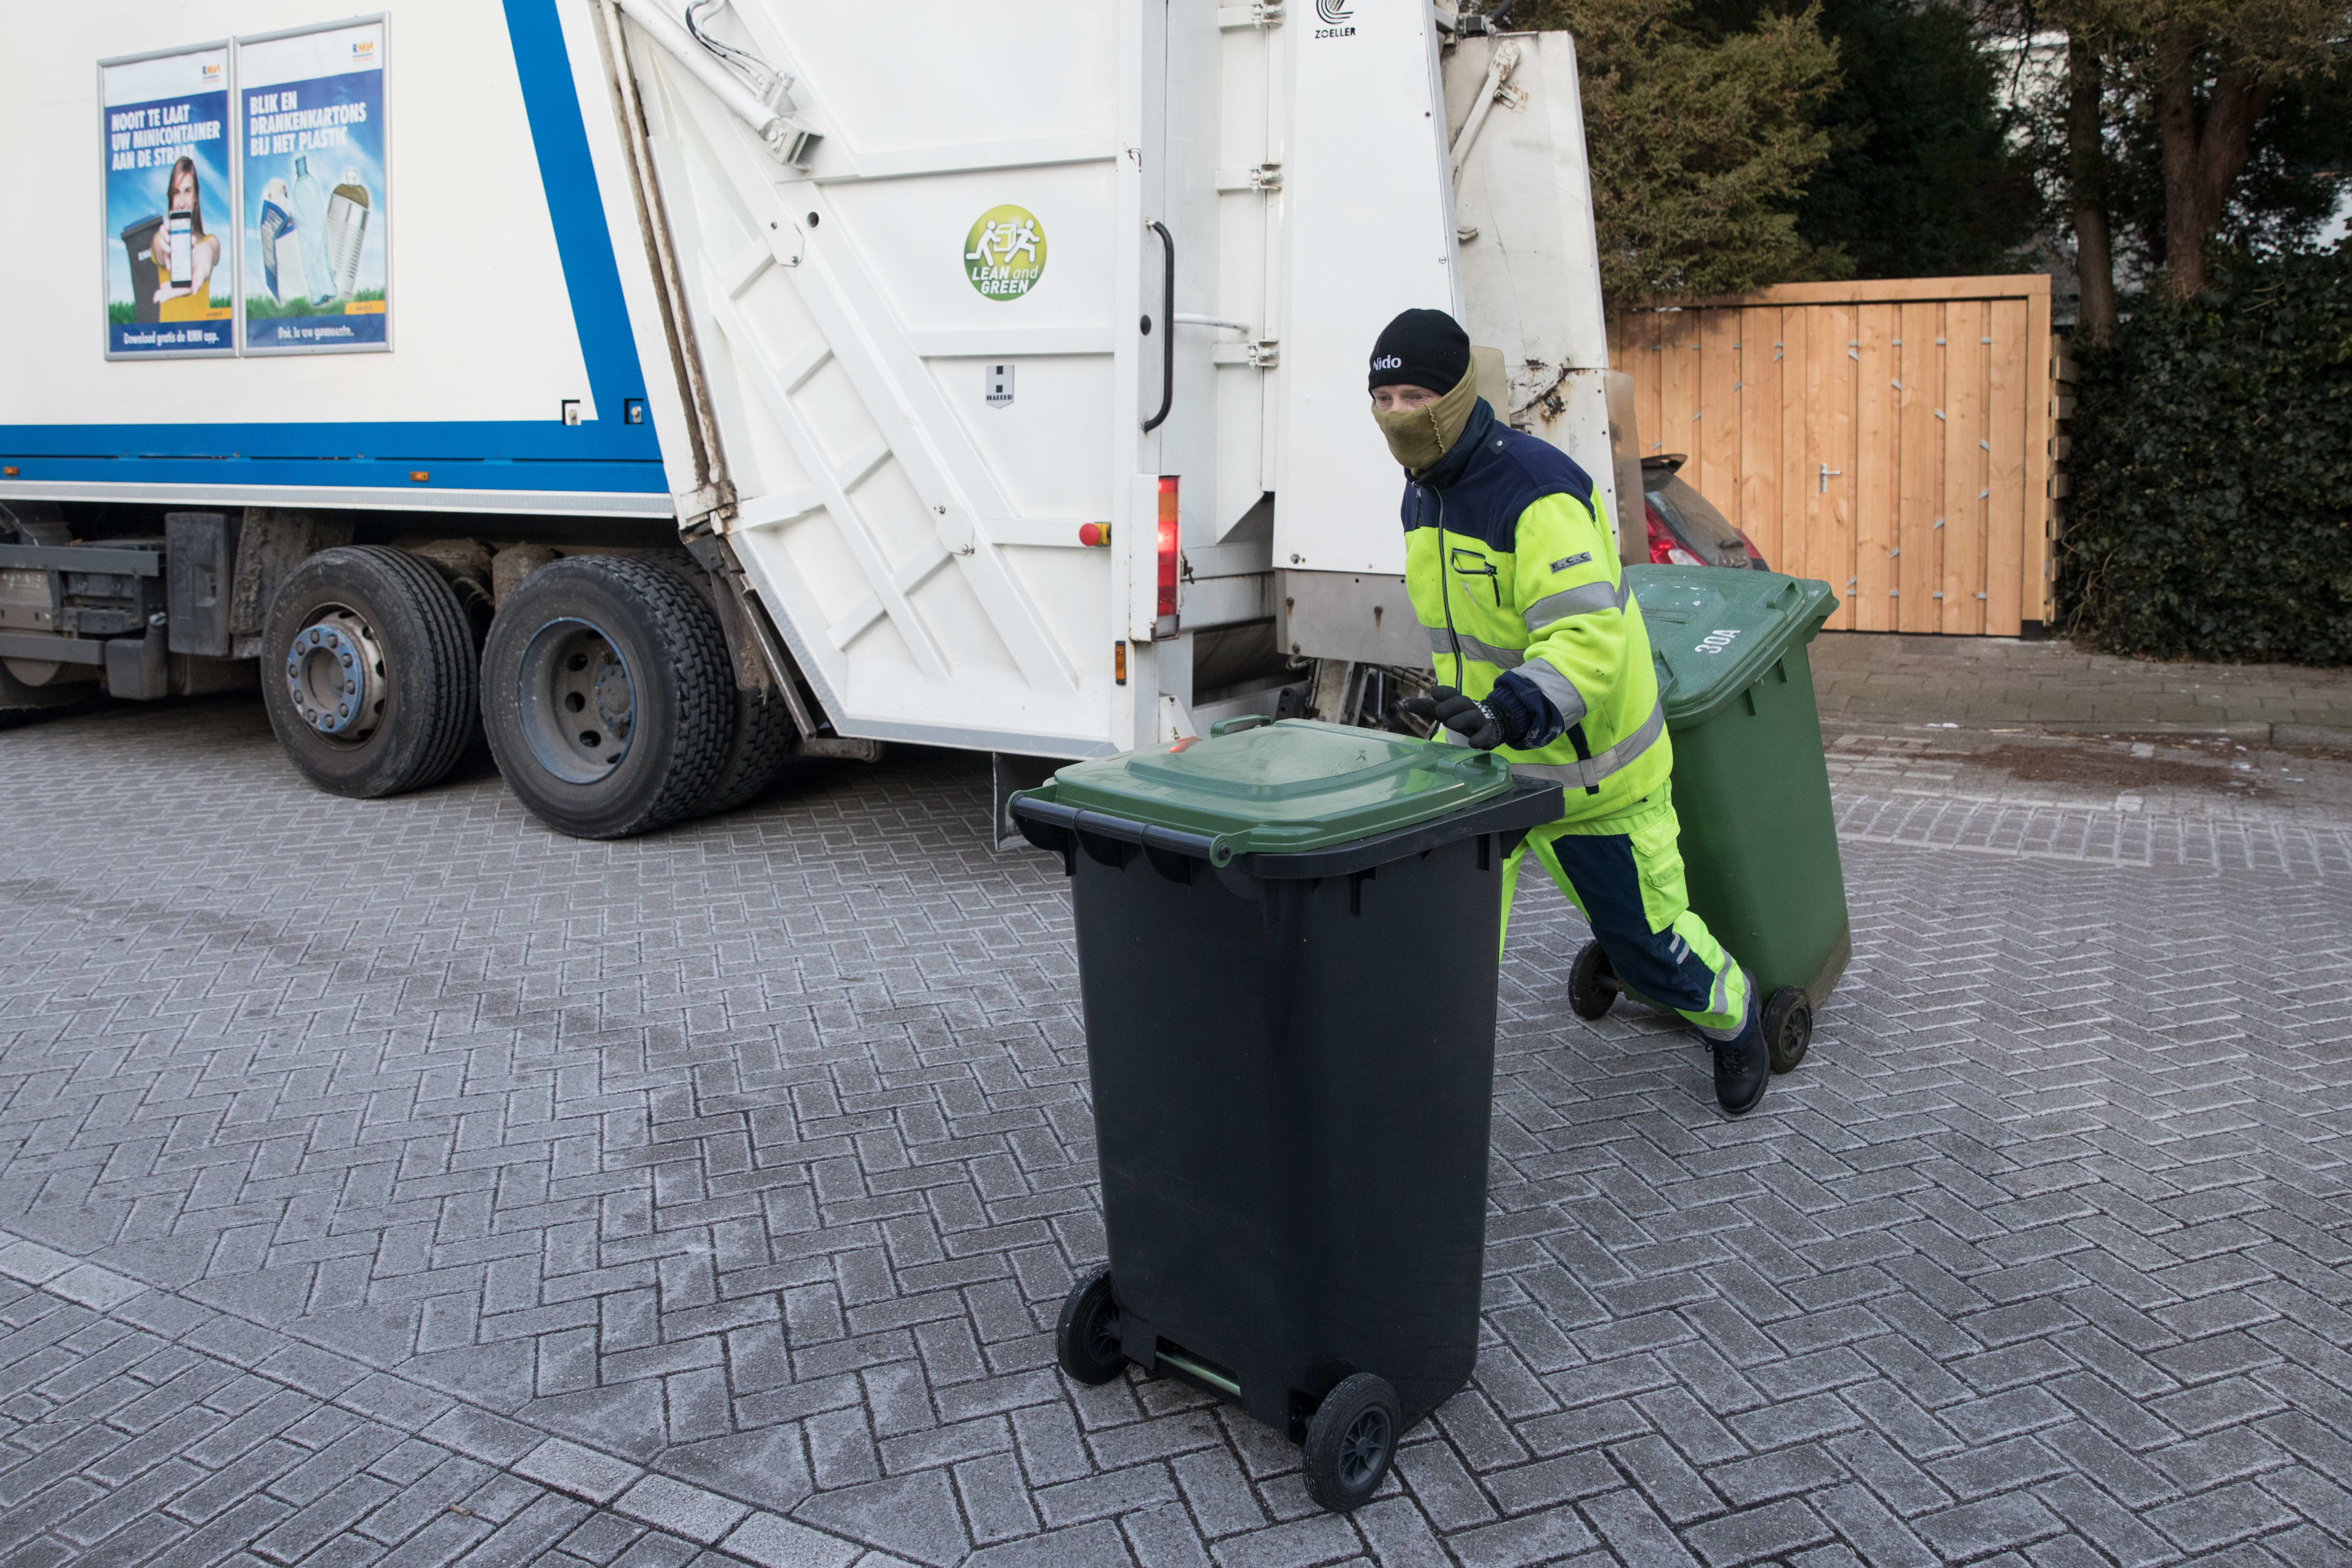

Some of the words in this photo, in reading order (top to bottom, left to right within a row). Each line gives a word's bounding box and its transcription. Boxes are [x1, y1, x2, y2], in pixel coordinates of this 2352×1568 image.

[1315, 27, 1355, 39] ZOELLER
[250, 93, 279, 116] BLIK
[281, 90, 298, 111] EN
[111, 110, 146, 132] NOOIT
[147, 108, 160, 127] TE
[162, 104, 190, 125] LAAT
[250, 102, 367, 136] DRANKENKARTONS
[111, 132, 131, 151] UW
[133, 120, 221, 149] MINICONTAINER
[250, 136, 270, 157] BIJ
[273, 132, 296, 154] HET
[299, 126, 349, 151] PLASTIC
[112, 151, 135, 171] AAN
[137, 149, 152, 168] DE
[154, 143, 195, 166] STRAAT
[972, 266, 1010, 281] LEAN
[1013, 265, 1039, 279] and
[981, 279, 1029, 294] GREEN
[124, 330, 156, 344] Download
[156, 331, 176, 347] gratis
[176, 330, 186, 342] de
[186, 330, 203, 342] RMN
[203, 331, 219, 344] app.
[277, 326, 292, 339] Ook
[293, 326, 300, 338] in
[301, 328, 313, 337] uw
[1373, 354, 1401, 371] Nido
[1694, 630, 1741, 654] 30A
